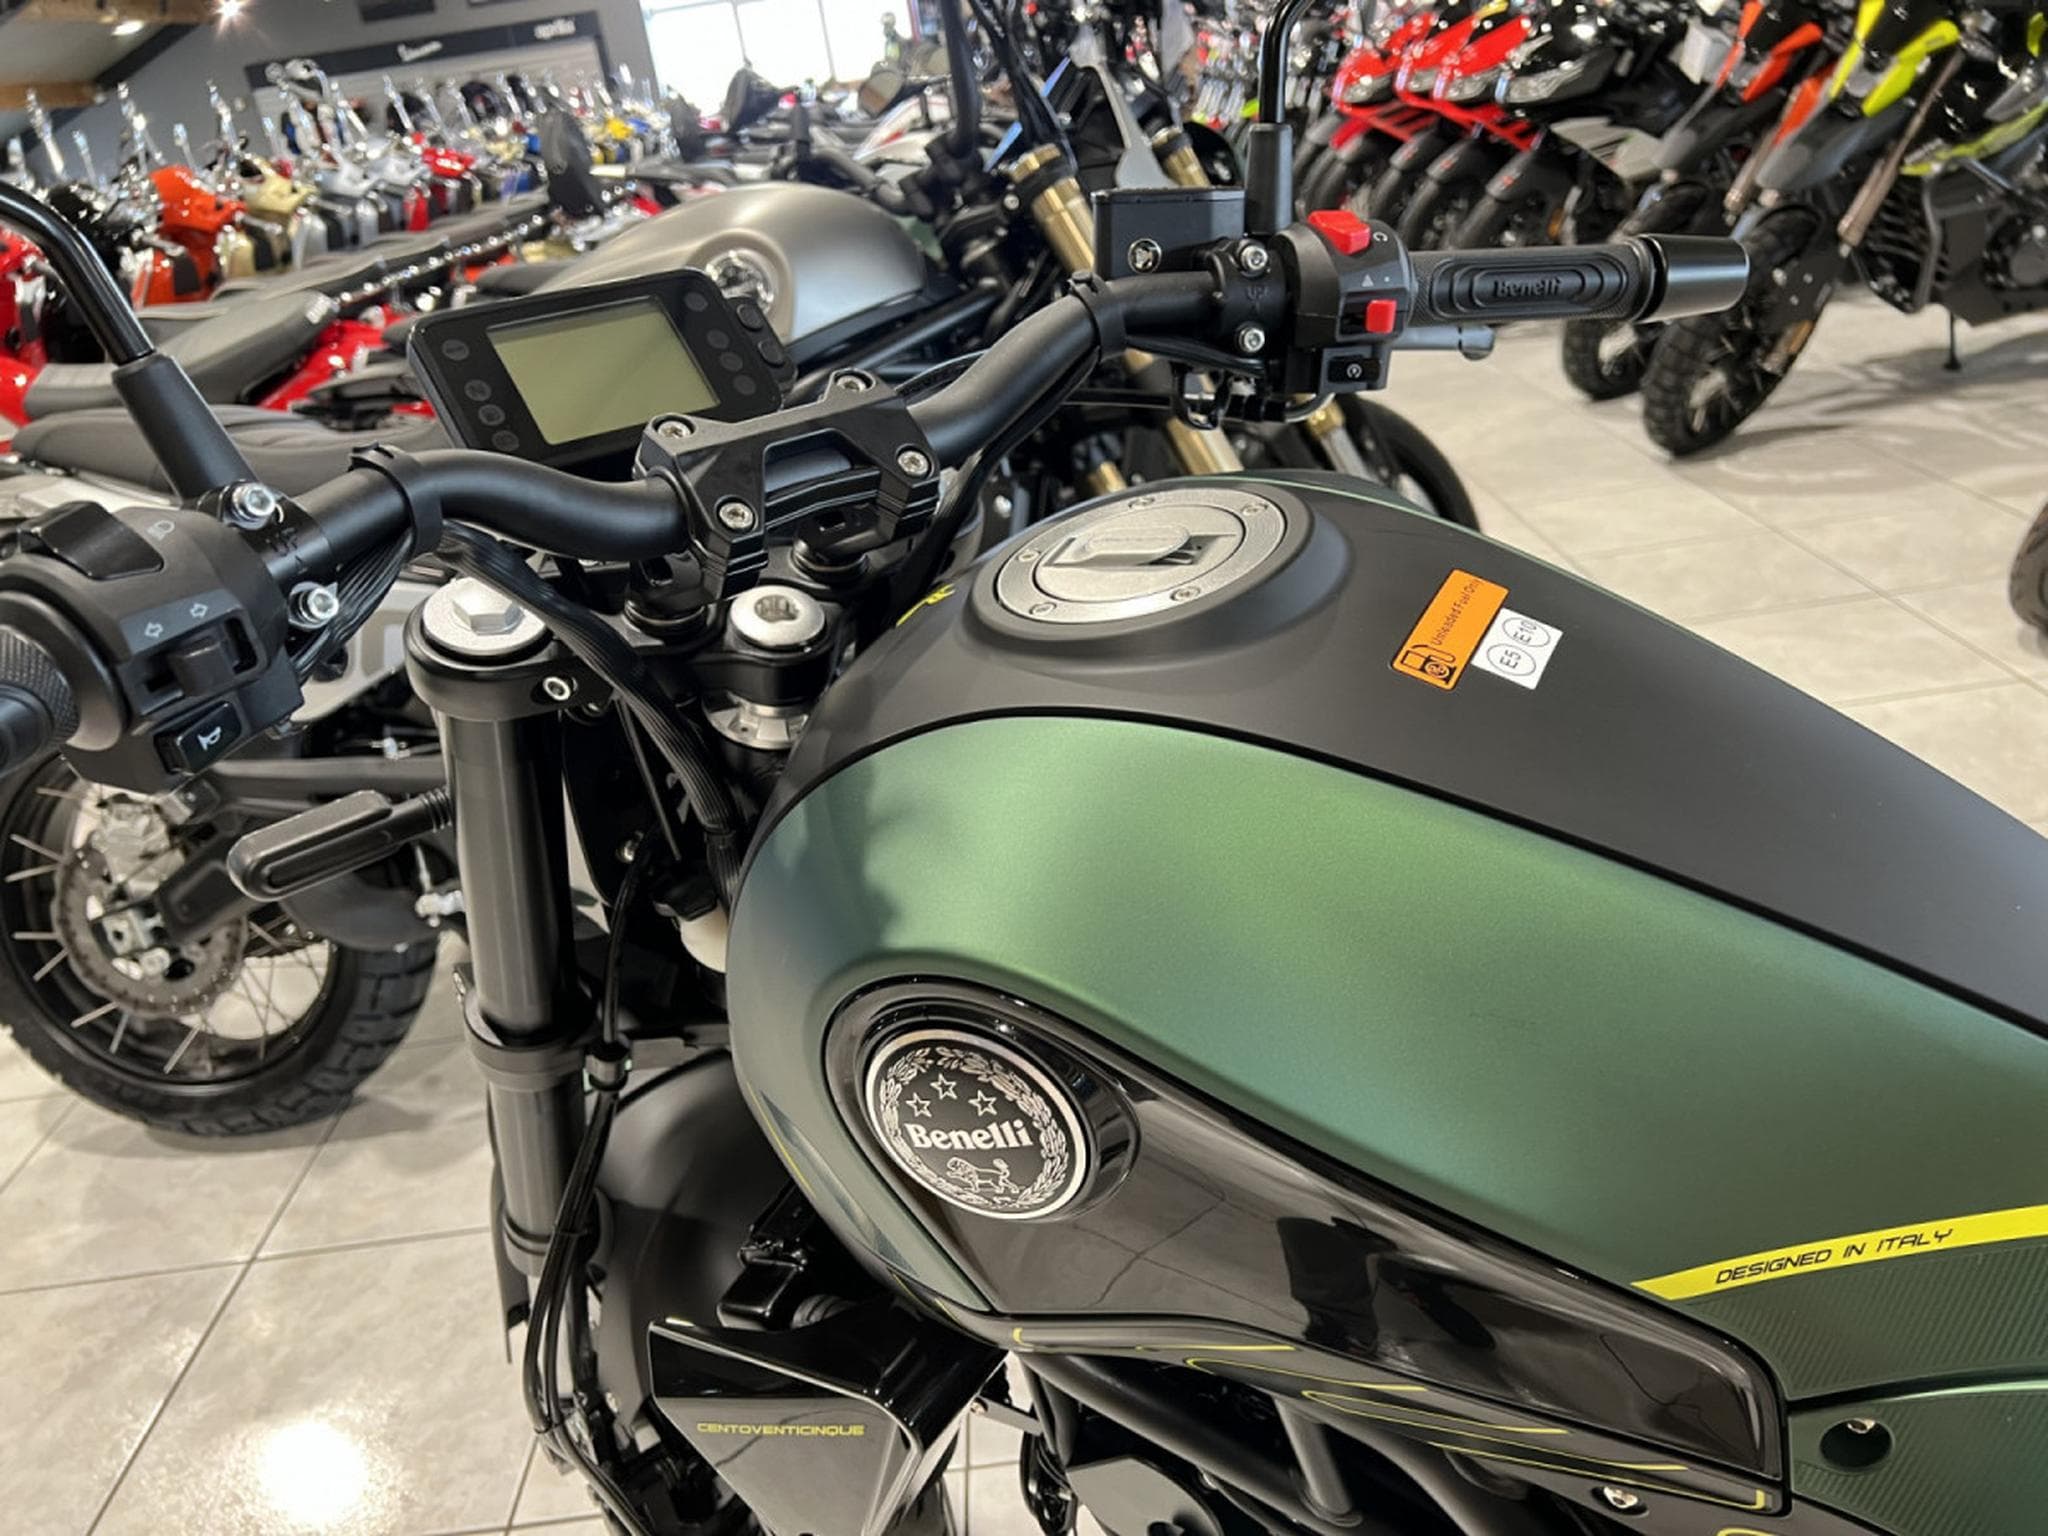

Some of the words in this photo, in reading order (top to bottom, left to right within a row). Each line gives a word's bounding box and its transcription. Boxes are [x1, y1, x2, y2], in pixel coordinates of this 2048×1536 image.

[1493, 277, 1563, 298] Benelli
[1499, 649, 1522, 669] E5
[1513, 620, 1537, 646] E10
[903, 1119, 1034, 1150] Benelli
[1715, 1248, 1833, 1285] DESIGNED
[1842, 1242, 1868, 1260] IN
[1876, 1228, 1953, 1253] ITALY
[696, 1422, 865, 1437] CENTOVENTICINQUE
